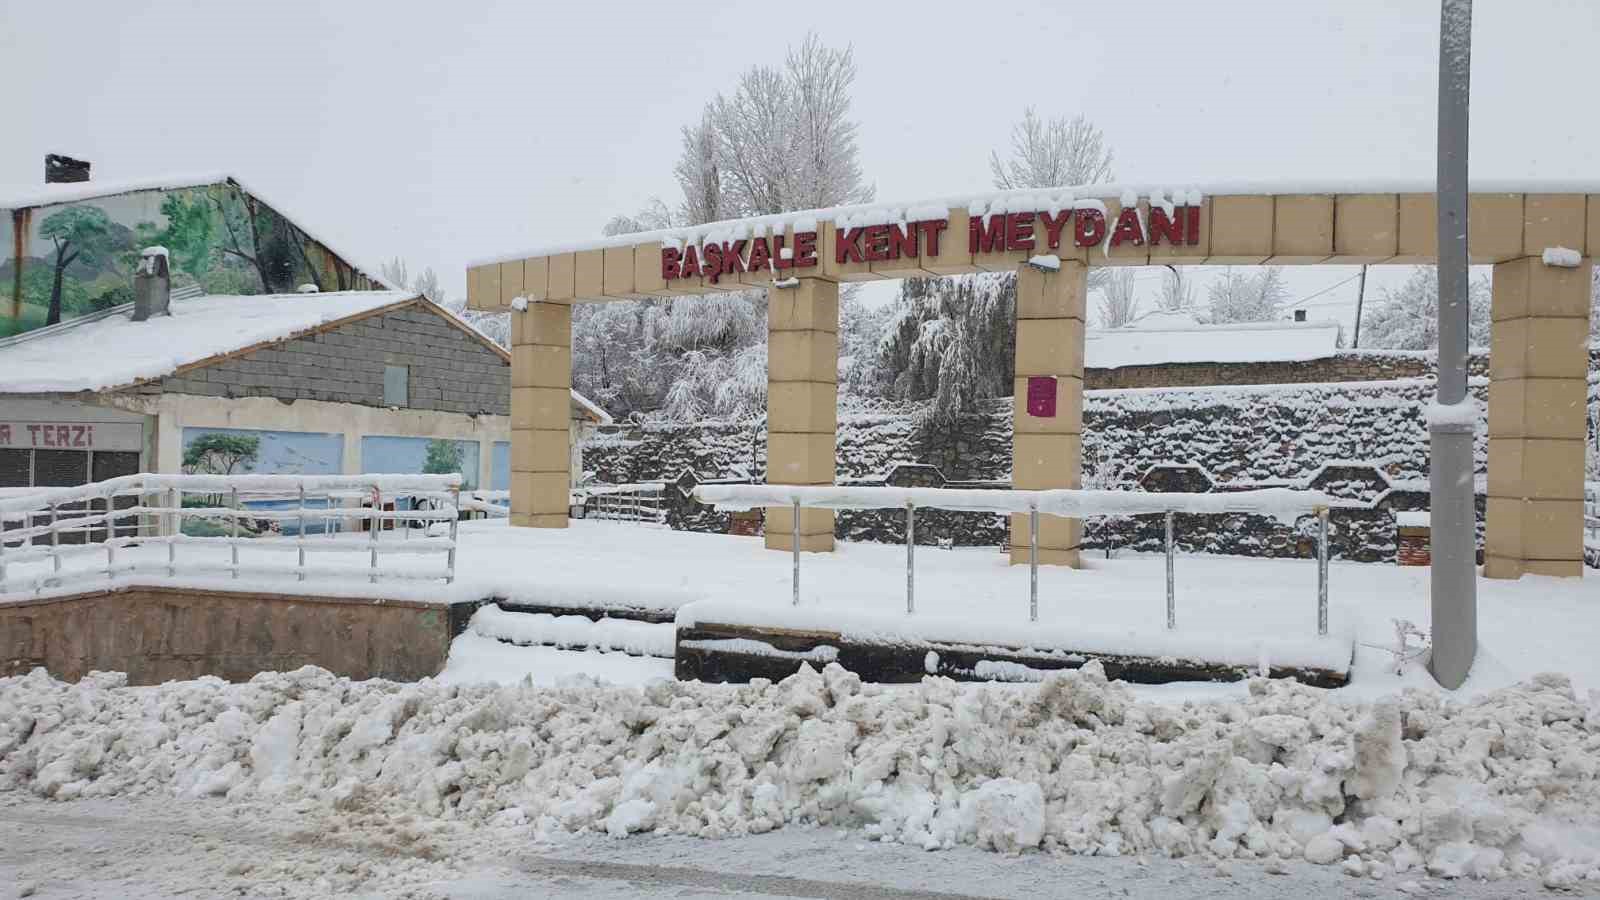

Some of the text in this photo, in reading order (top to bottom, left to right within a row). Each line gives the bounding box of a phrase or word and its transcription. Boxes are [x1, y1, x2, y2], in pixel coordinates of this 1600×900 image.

[661, 205, 1201, 284] BAŞKALE KENT MEYDANI
